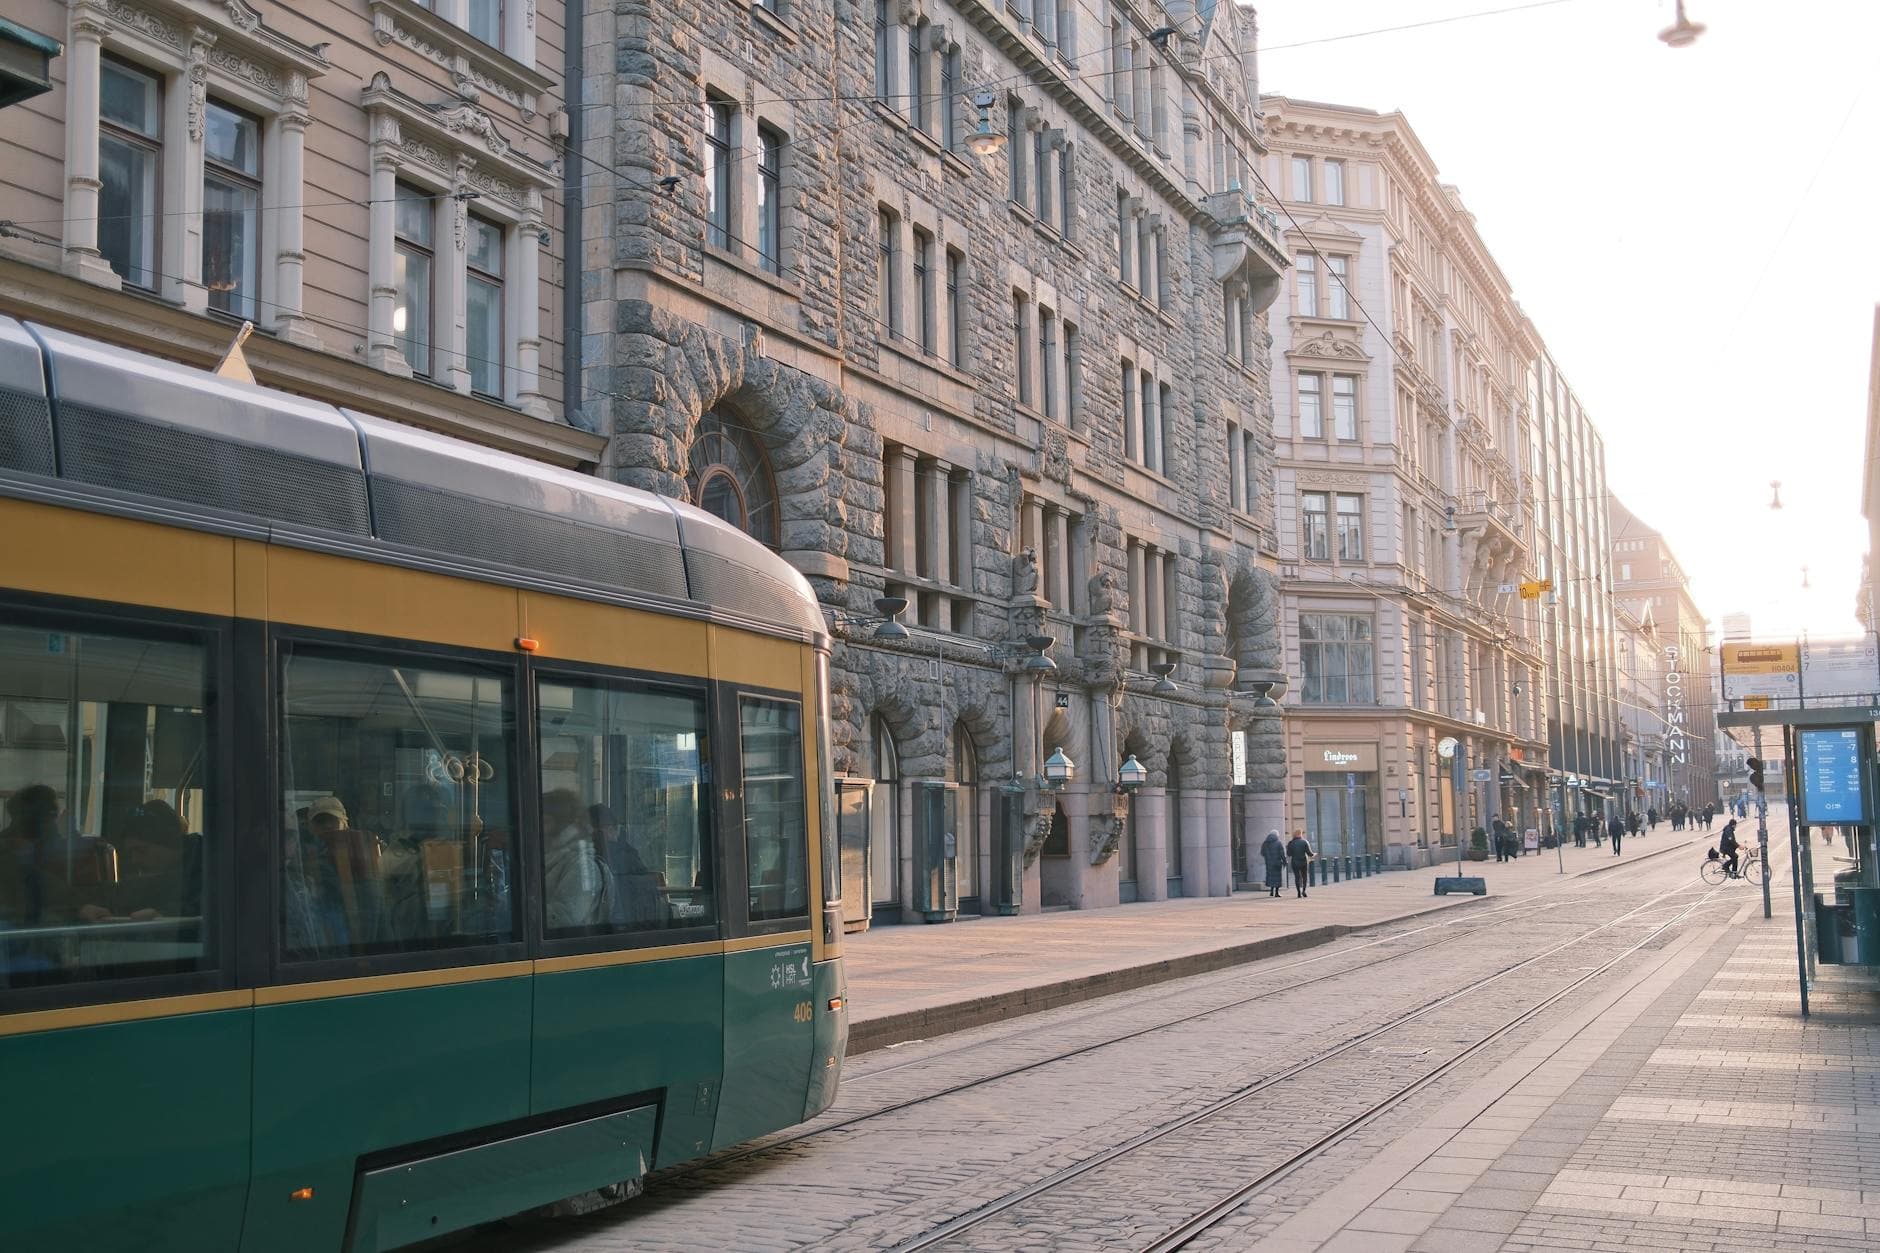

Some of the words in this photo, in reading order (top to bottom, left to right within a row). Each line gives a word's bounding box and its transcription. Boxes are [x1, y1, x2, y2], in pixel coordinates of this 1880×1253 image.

[1057, 696, 1068, 706] 44
[1664, 645, 1685, 764] STOCKMANN
[1234, 734, 1242, 784] ARKET
[1324, 750, 1358, 761] Lindroos
[794, 1001, 813, 1022] 406
